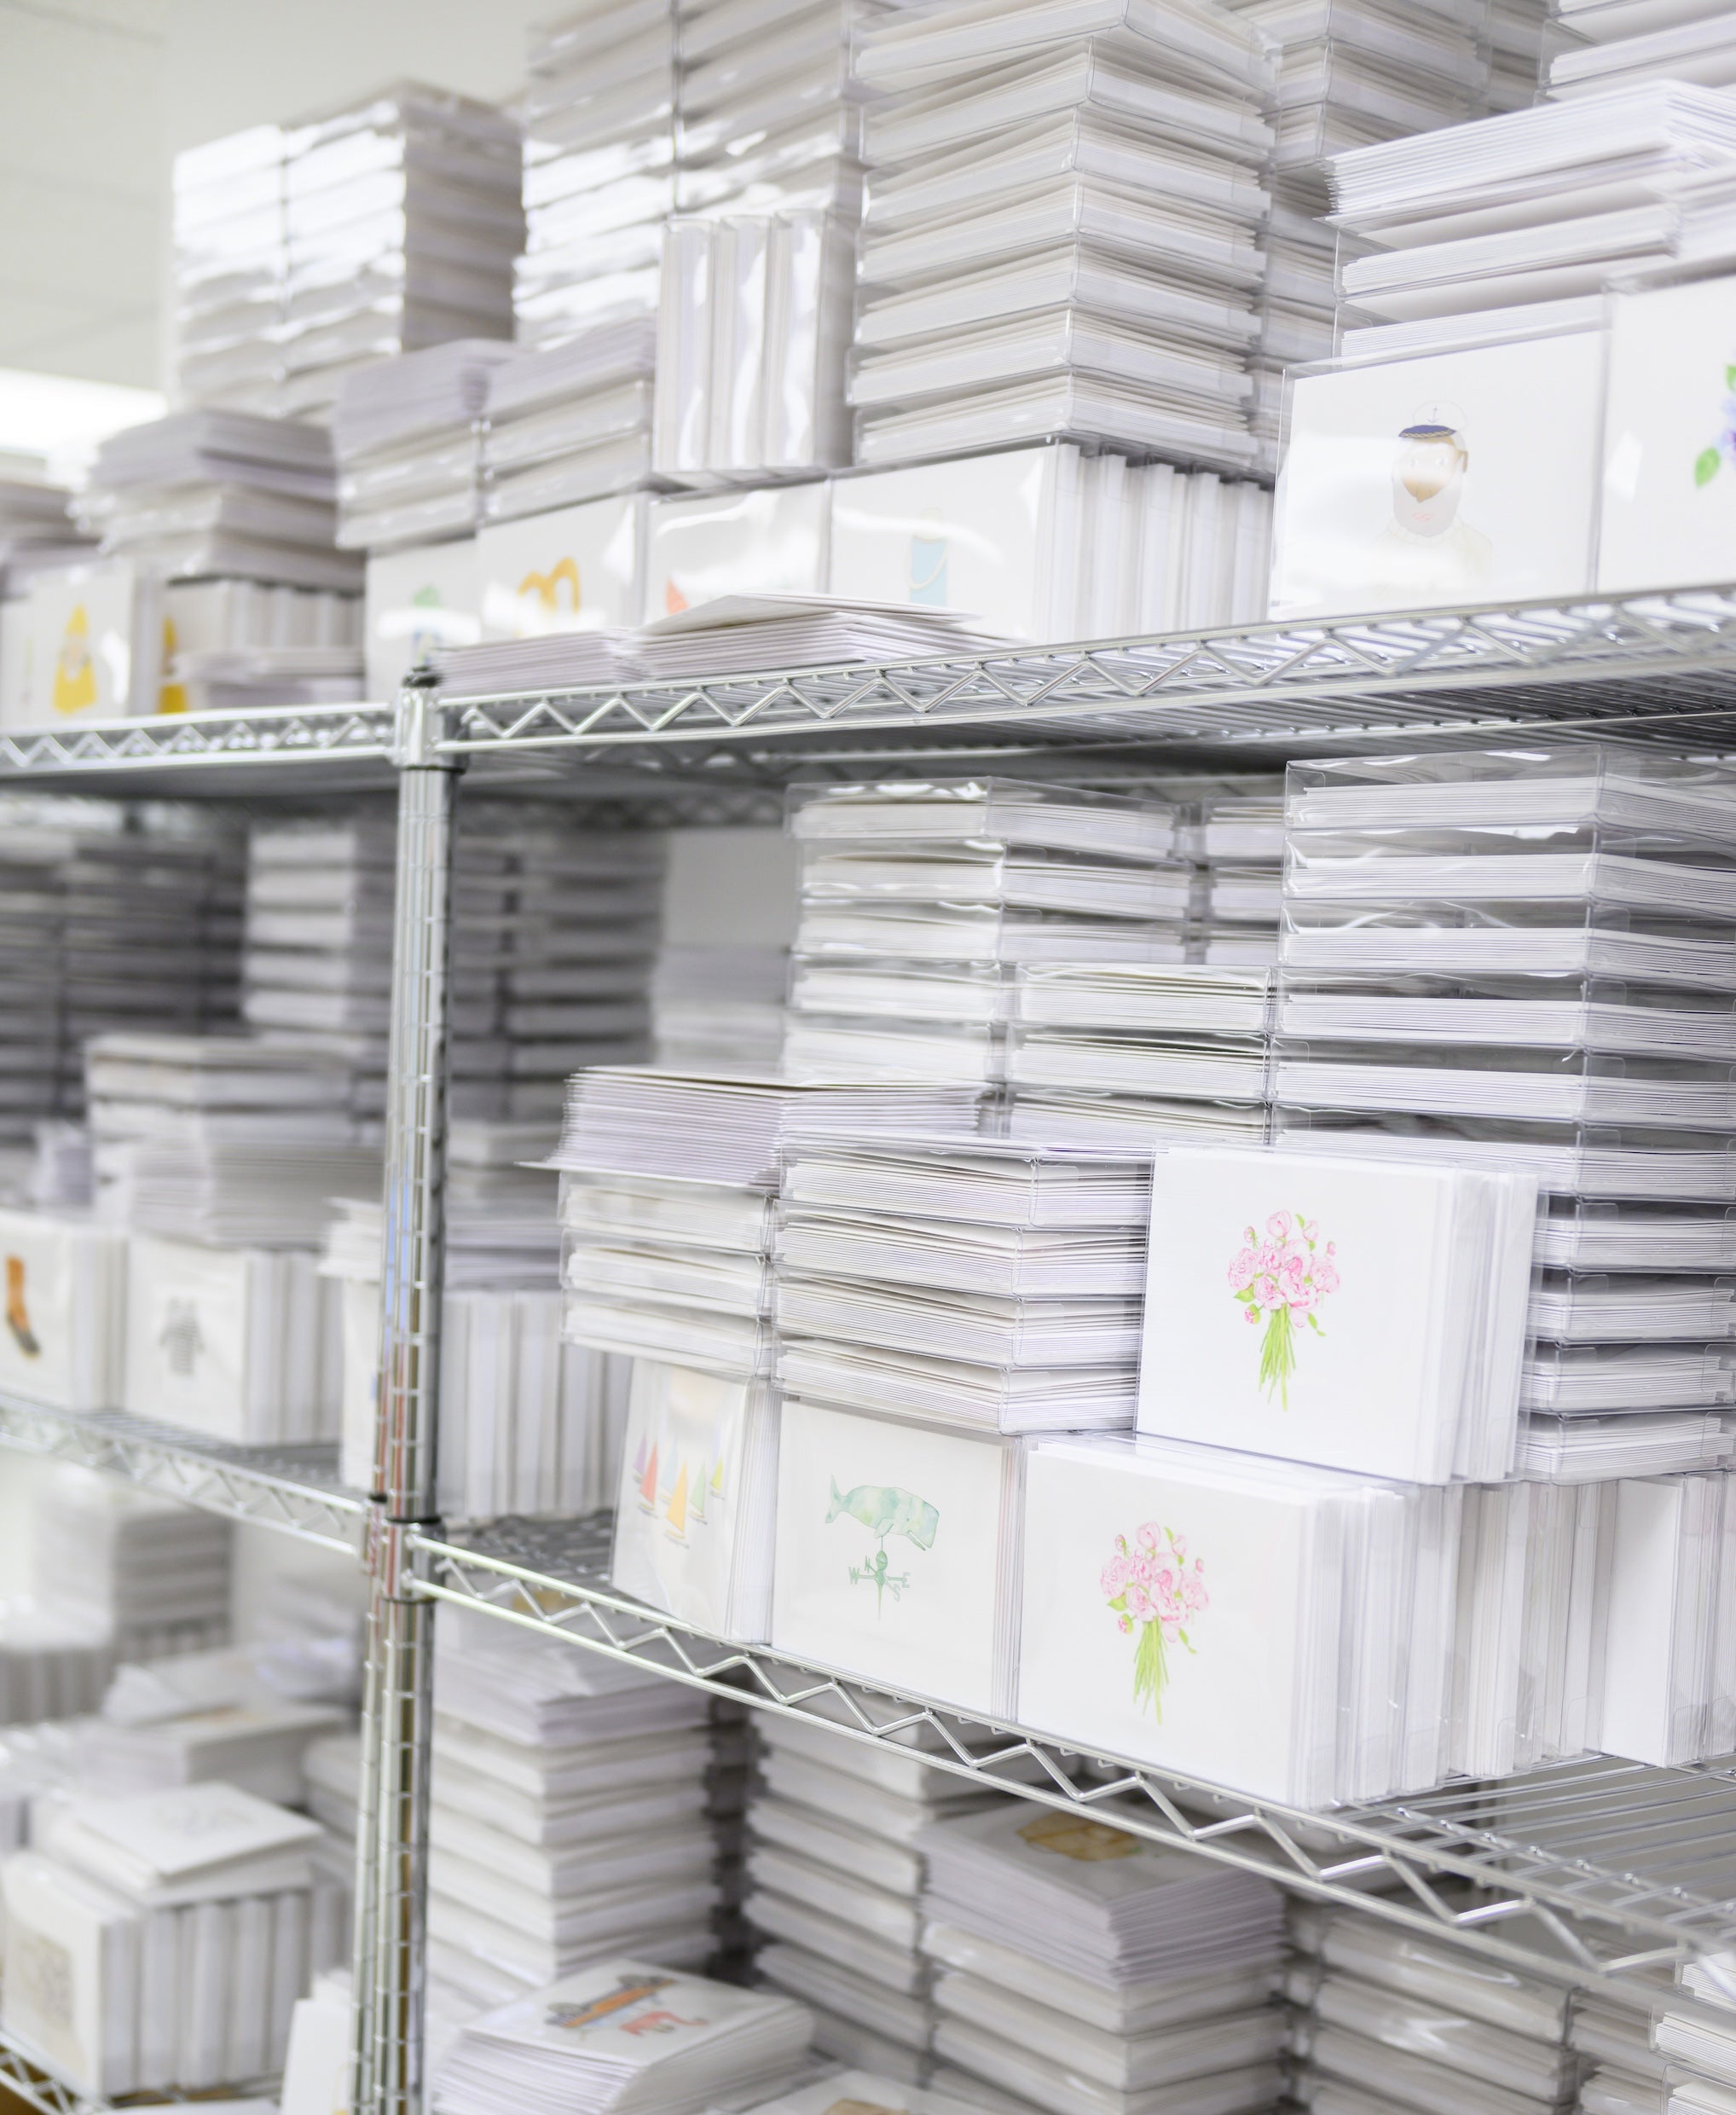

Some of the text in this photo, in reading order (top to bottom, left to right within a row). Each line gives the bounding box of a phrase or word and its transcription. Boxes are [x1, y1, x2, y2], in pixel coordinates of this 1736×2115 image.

[848, 1566, 859, 1585] W
[902, 1572, 911, 1589] E
[894, 1583, 900, 1602] S
